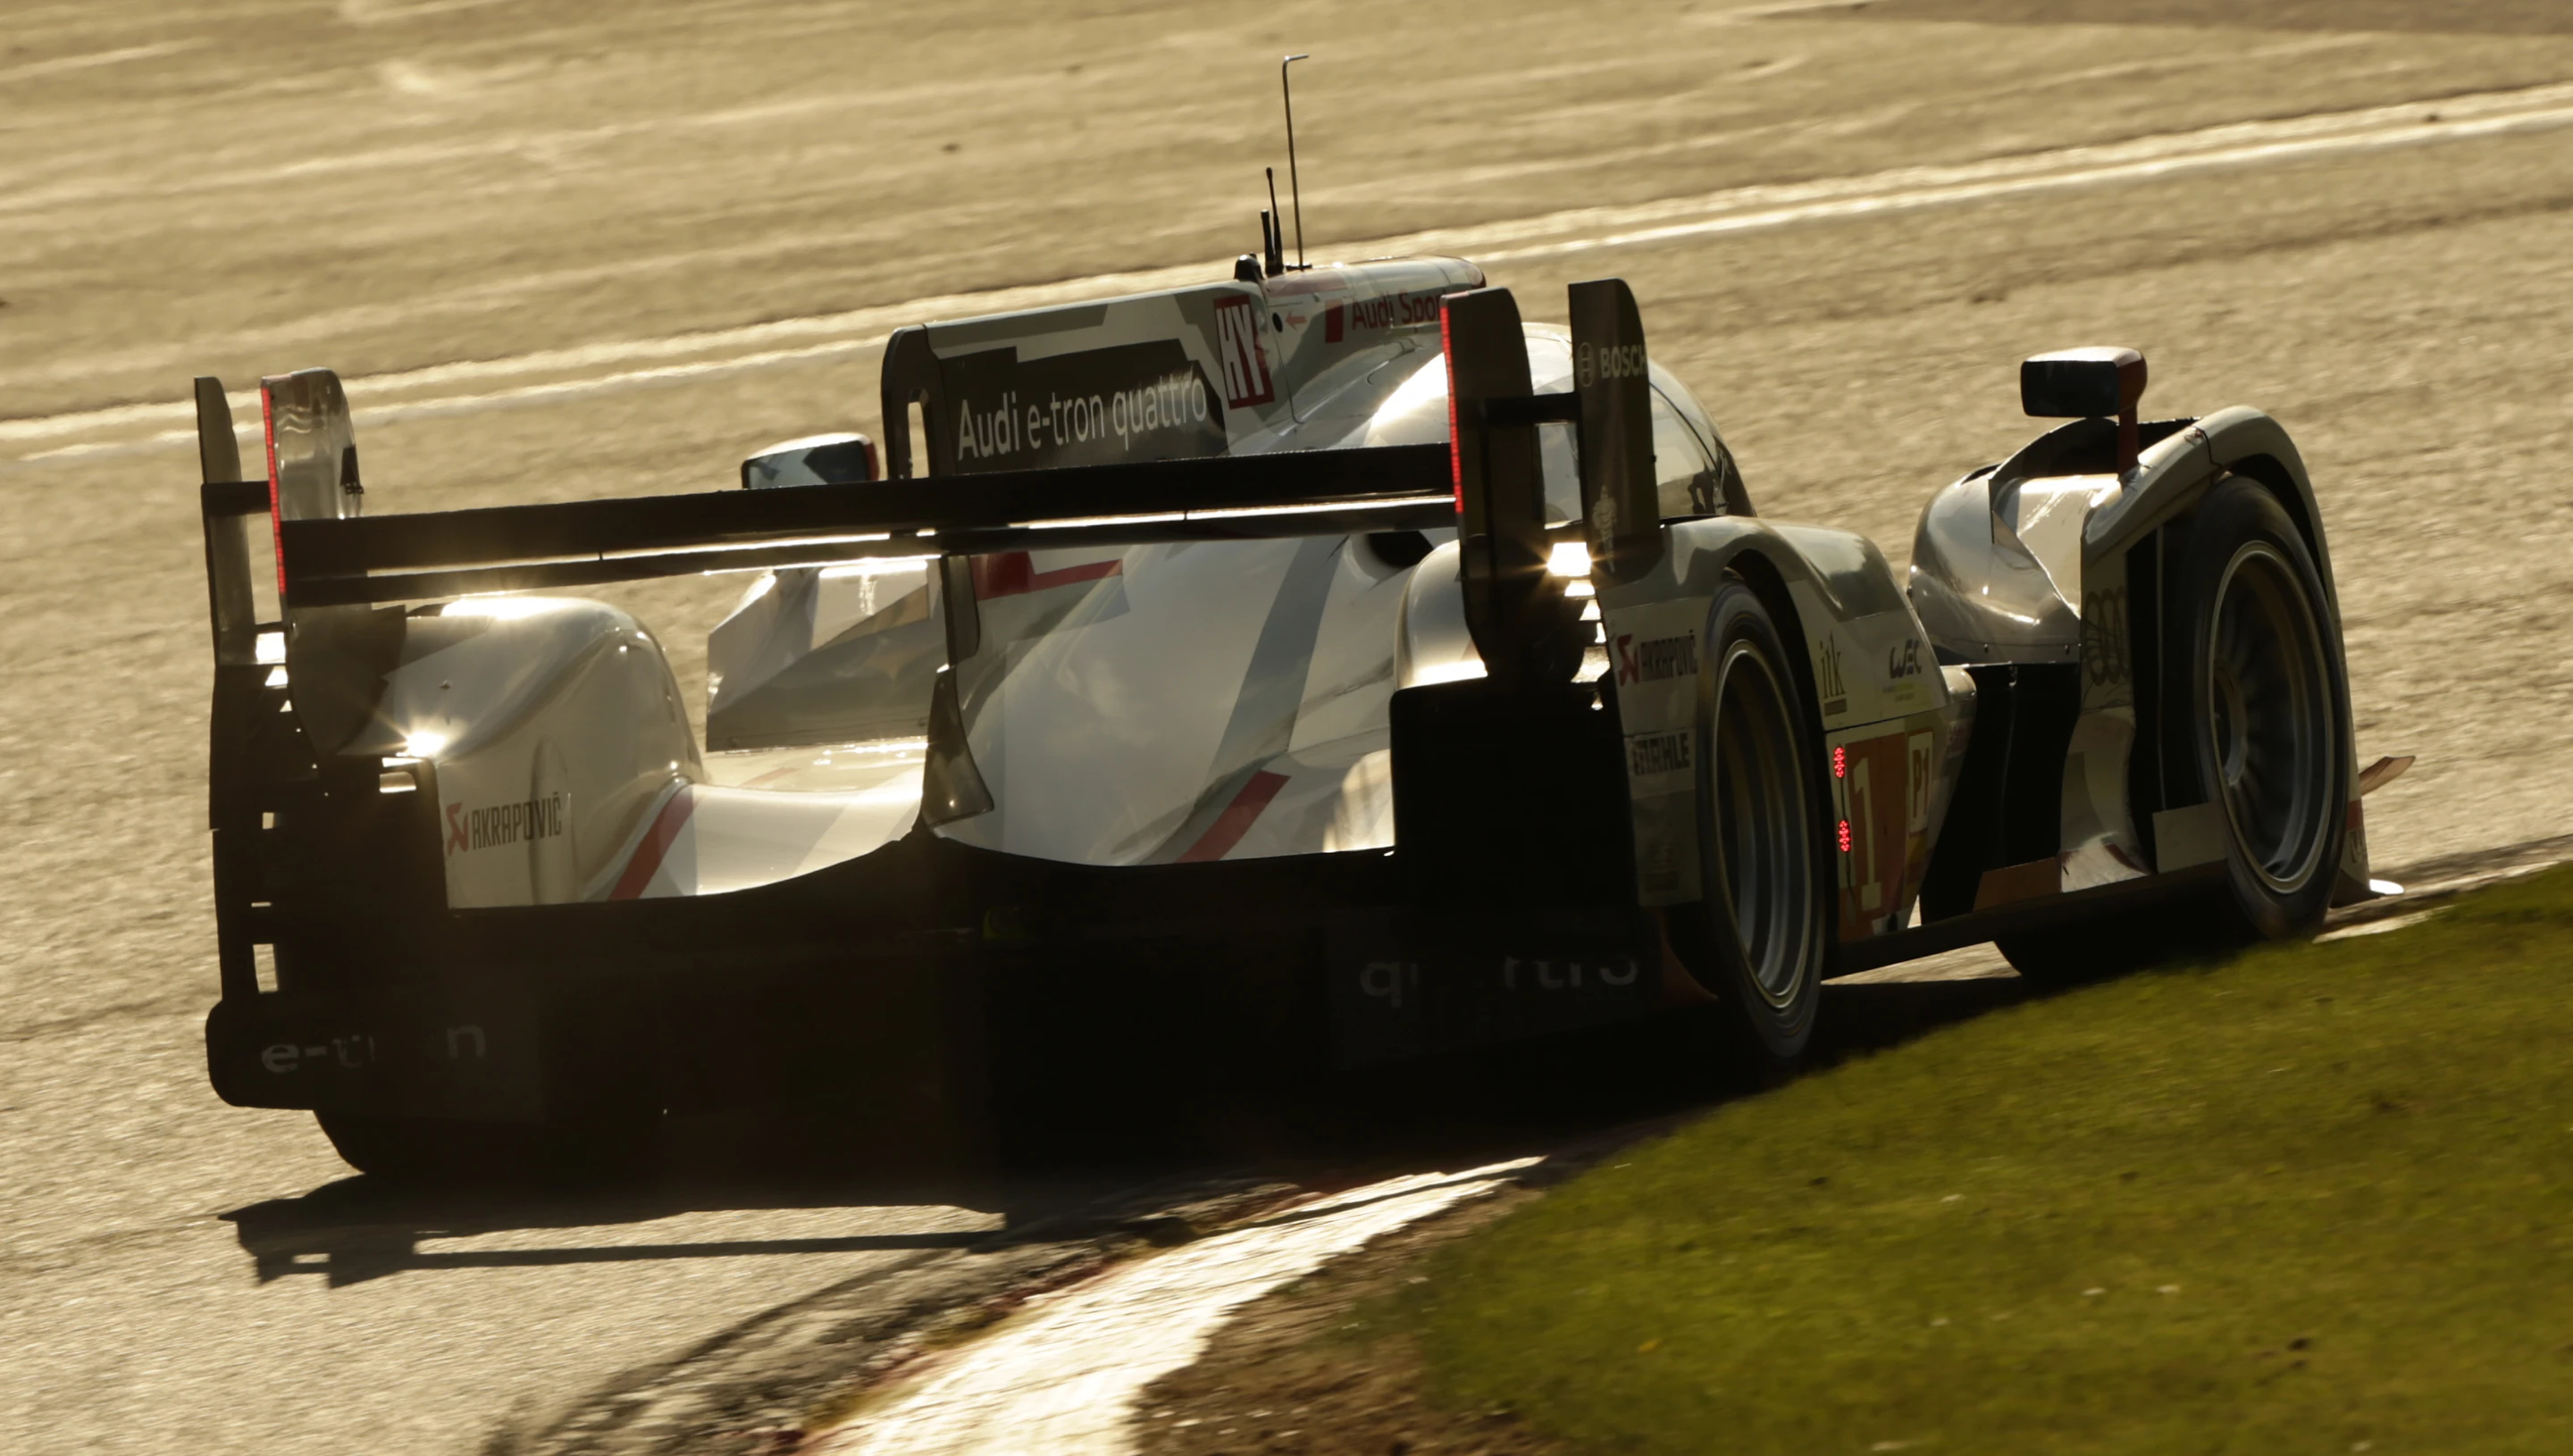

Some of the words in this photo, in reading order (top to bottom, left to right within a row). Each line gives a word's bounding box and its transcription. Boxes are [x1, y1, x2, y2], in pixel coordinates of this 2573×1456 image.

[1215, 303, 1266, 401] HY
[1353, 292, 1394, 330] Audi
[1399, 289, 1441, 325] Spor
[1599, 343, 1648, 380] BOSCH
[958, 390, 1020, 461] Audi
[1027, 390, 1105, 449] e-tron
[1112, 367, 1208, 450] quattro
[1853, 757, 1882, 911] 1
